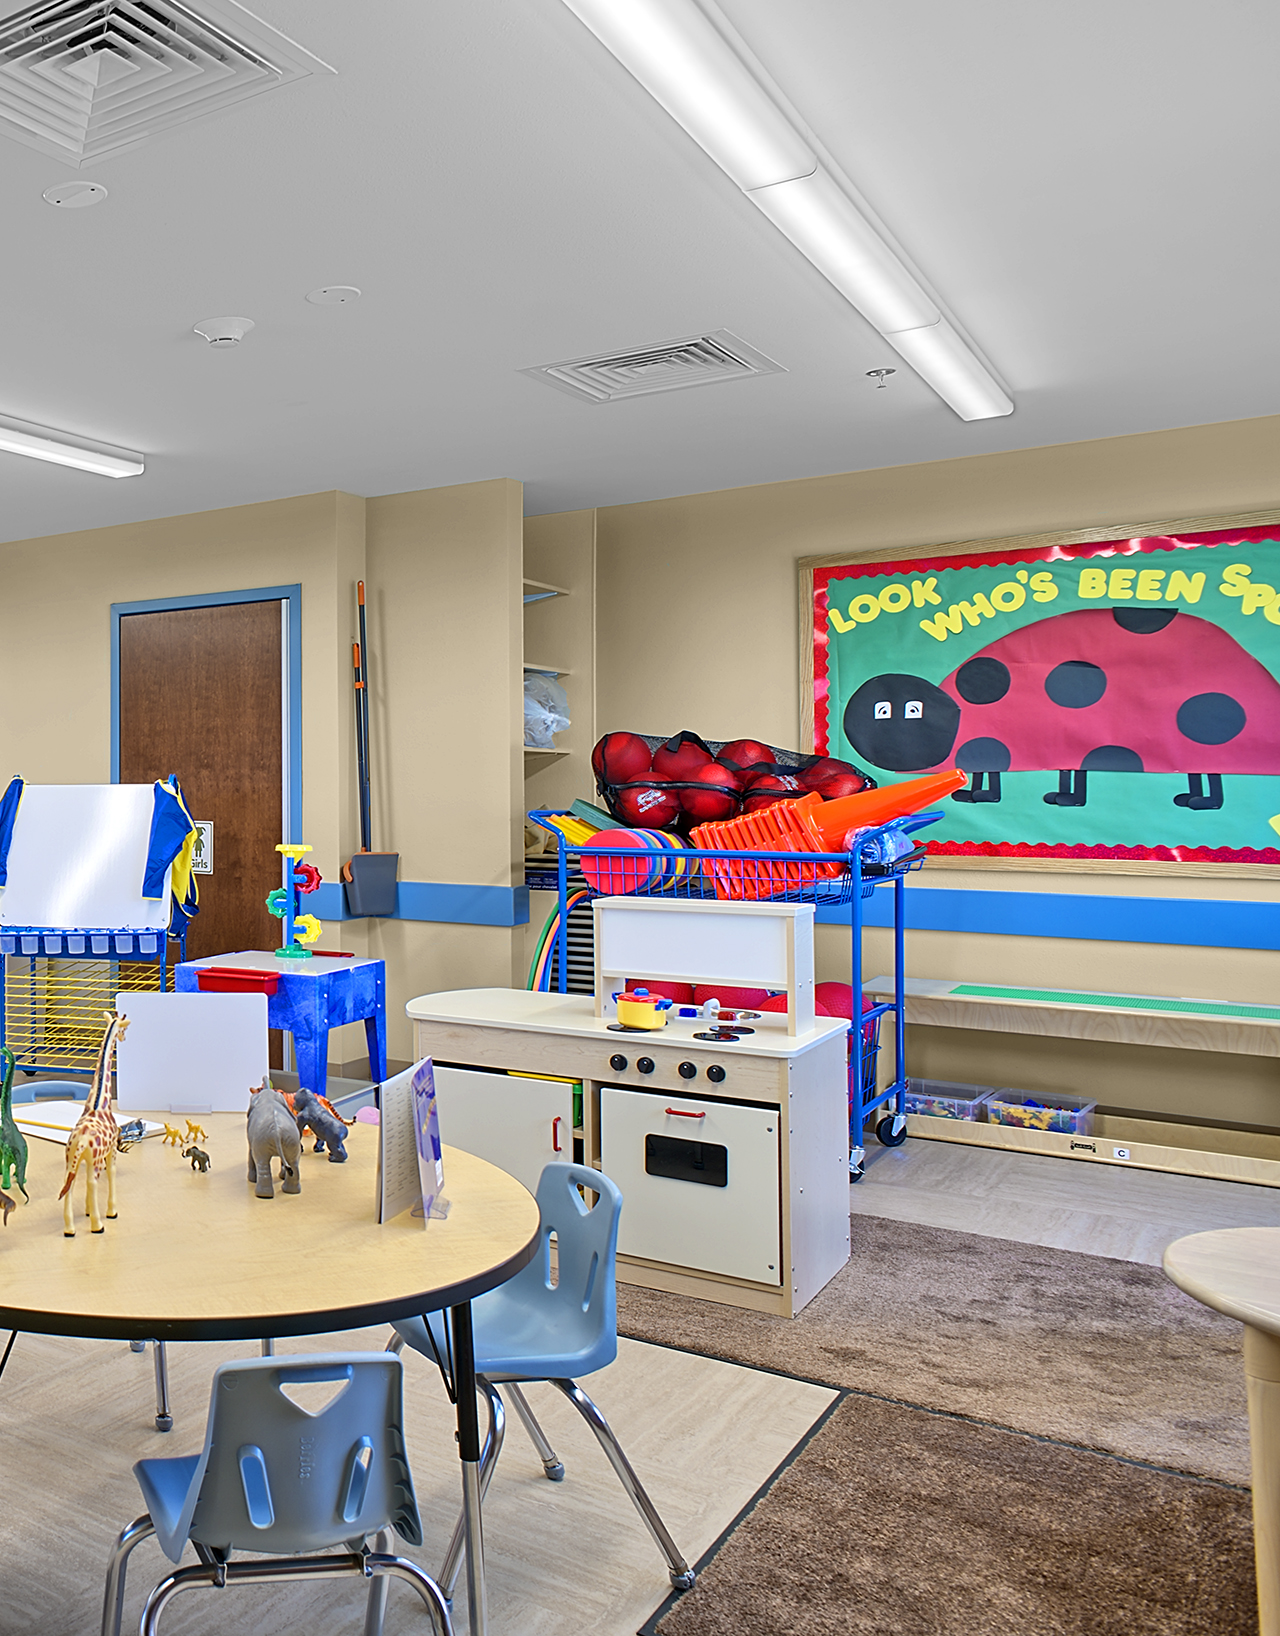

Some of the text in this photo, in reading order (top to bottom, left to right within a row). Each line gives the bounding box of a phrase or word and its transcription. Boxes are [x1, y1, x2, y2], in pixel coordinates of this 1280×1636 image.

[828, 577, 942, 634] LOOK
[919, 569, 1059, 642] WHO'S
[1077, 568, 1207, 604] BEEN
[1117, 1149, 1126, 1158] C
